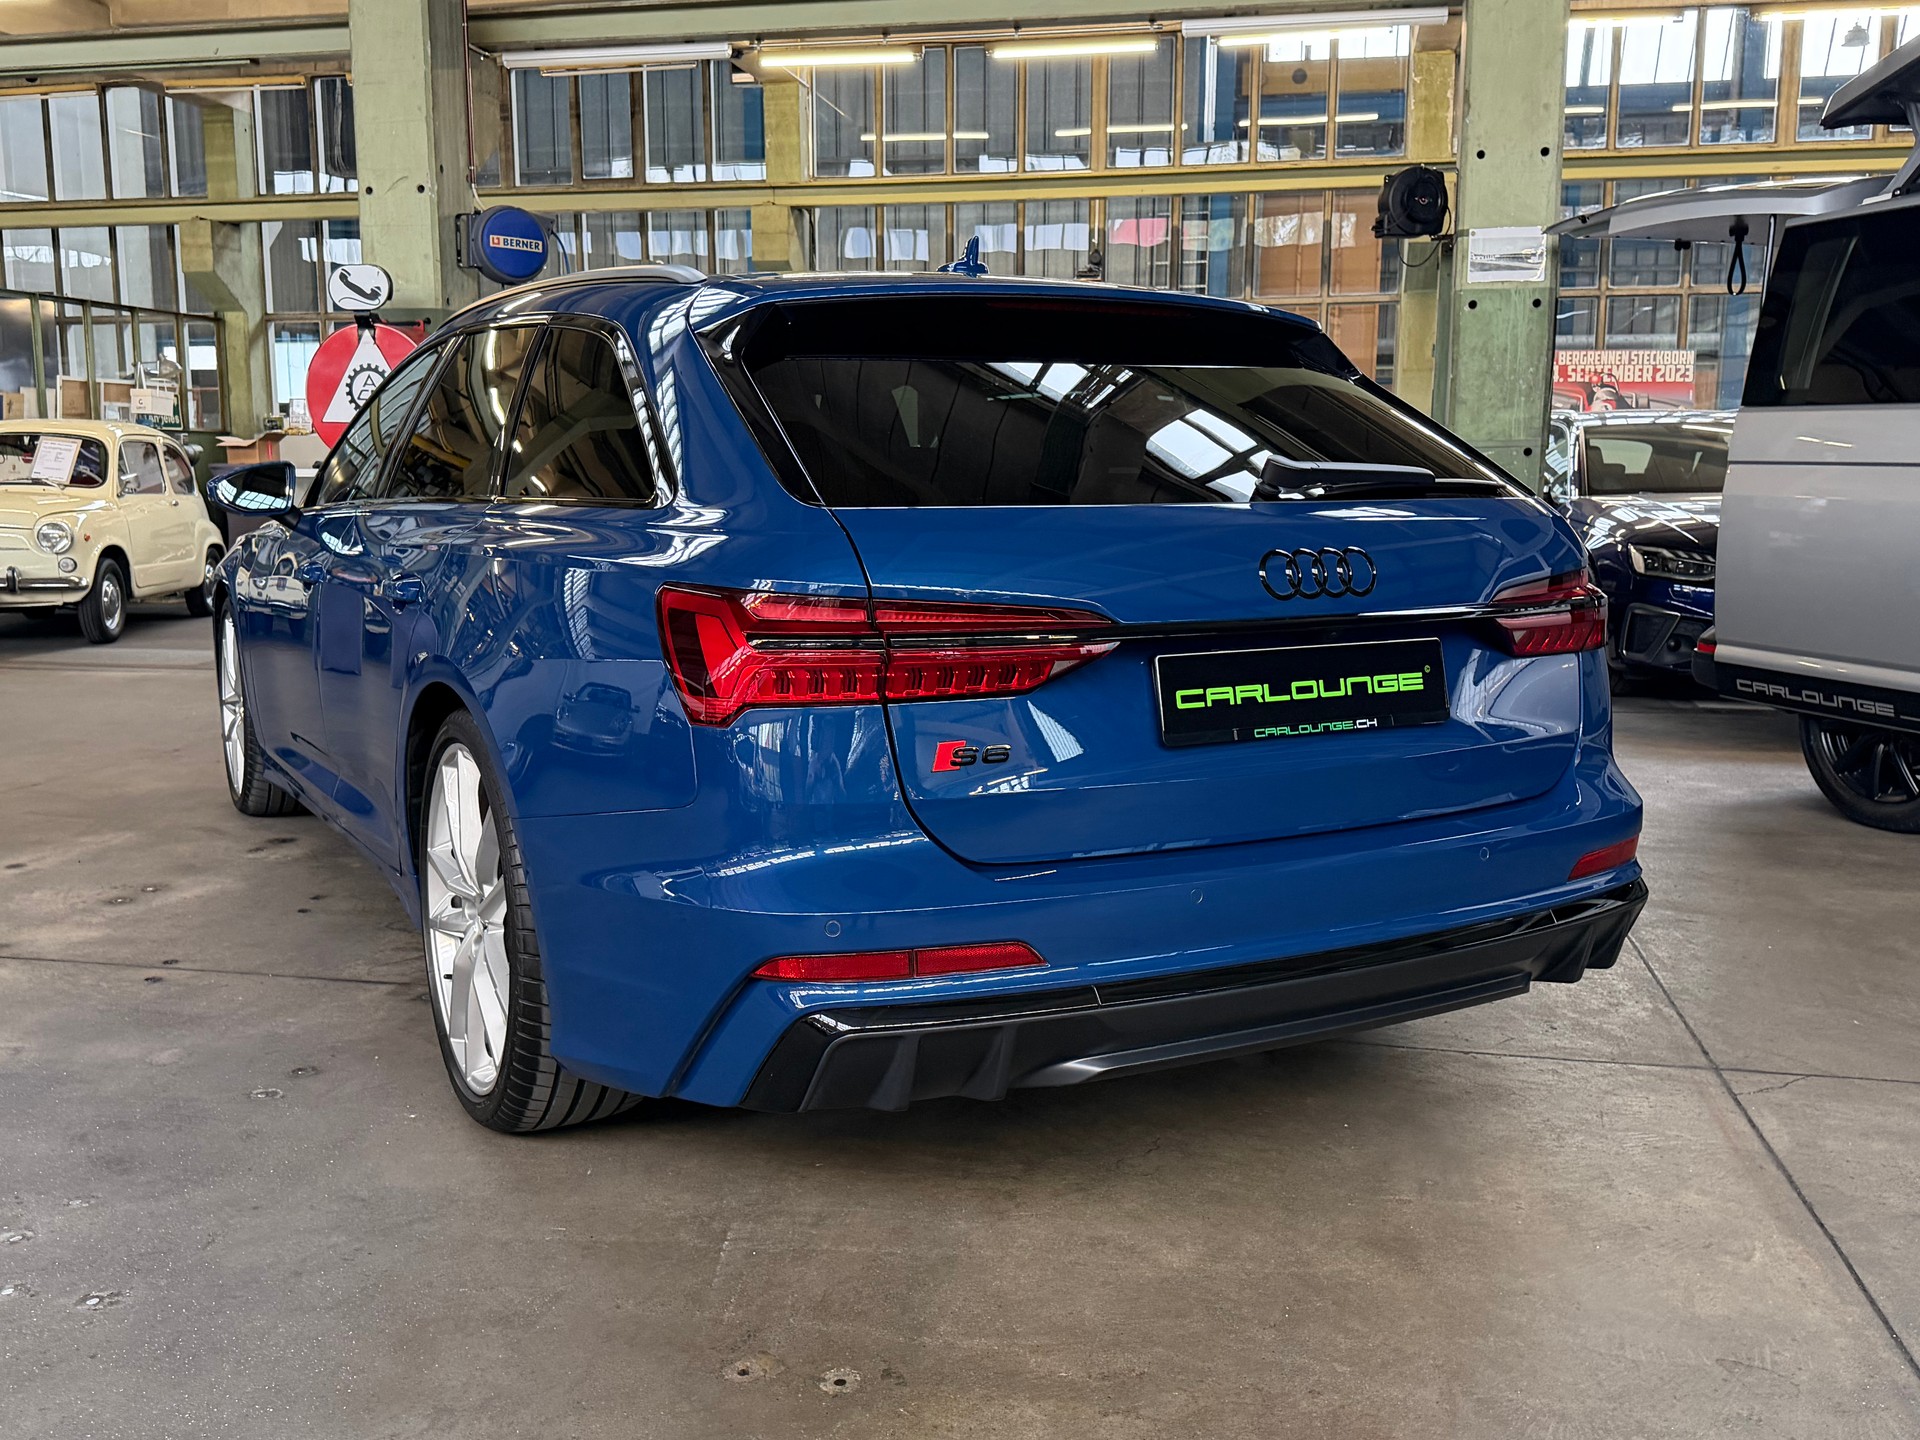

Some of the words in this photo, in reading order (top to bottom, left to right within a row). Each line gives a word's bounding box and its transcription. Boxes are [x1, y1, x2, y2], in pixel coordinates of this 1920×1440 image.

[503, 237, 540, 251] BERNER
[1559, 350, 1629, 365] BERGRENNEN
[1631, 350, 1695, 365] STECKBORN
[363, 373, 377, 388] A
[1655, 364, 1694, 383] 2023
[1175, 671, 1424, 709] CARLOUNGE
[1736, 678, 1895, 718] CARLOUNGE
[1253, 717, 1378, 738] CARLOUNGE.CH
[949, 743, 1012, 767] S6
